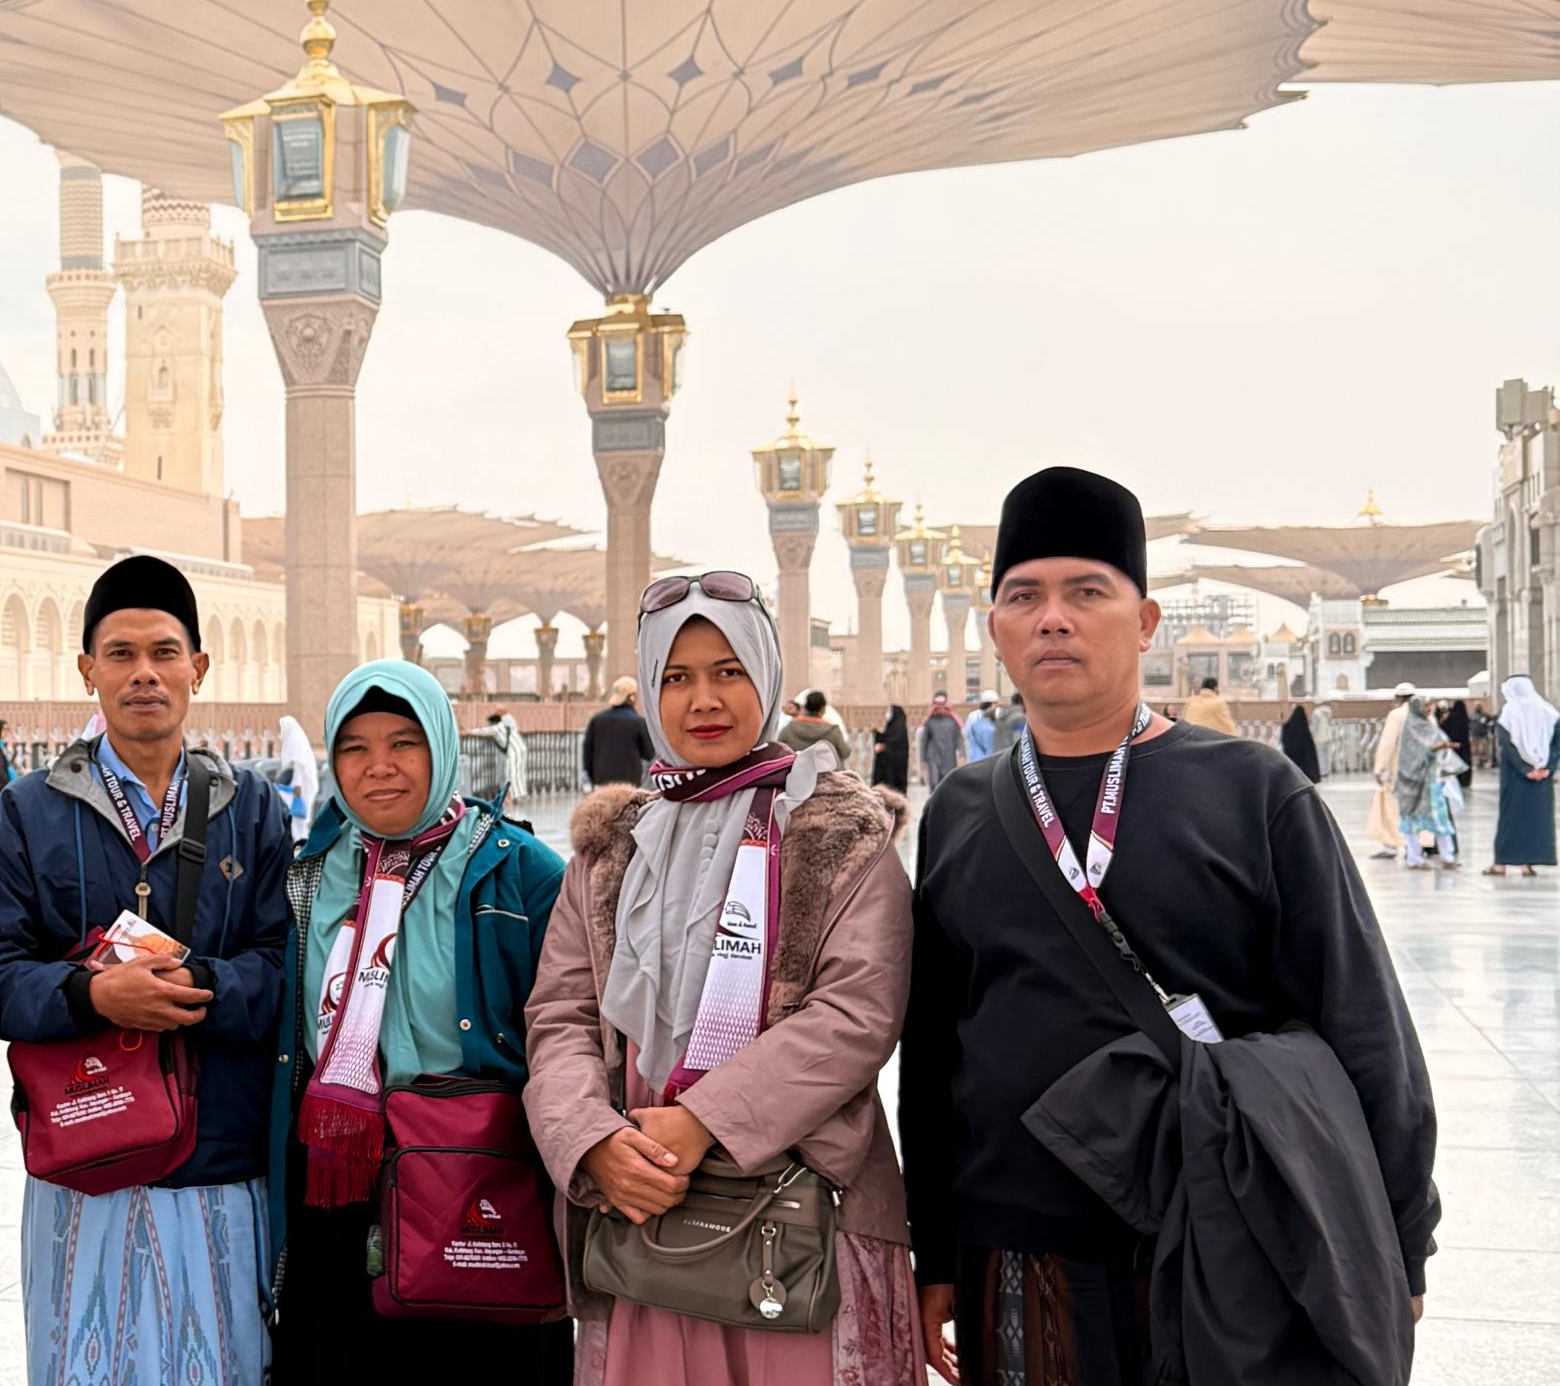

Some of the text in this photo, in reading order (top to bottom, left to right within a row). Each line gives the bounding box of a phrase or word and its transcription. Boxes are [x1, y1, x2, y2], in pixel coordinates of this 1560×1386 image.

[106, 774, 124, 801] TOUR
[120, 803, 141, 842] TRAVEL
[1032, 790, 1054, 828] TRAVEL
